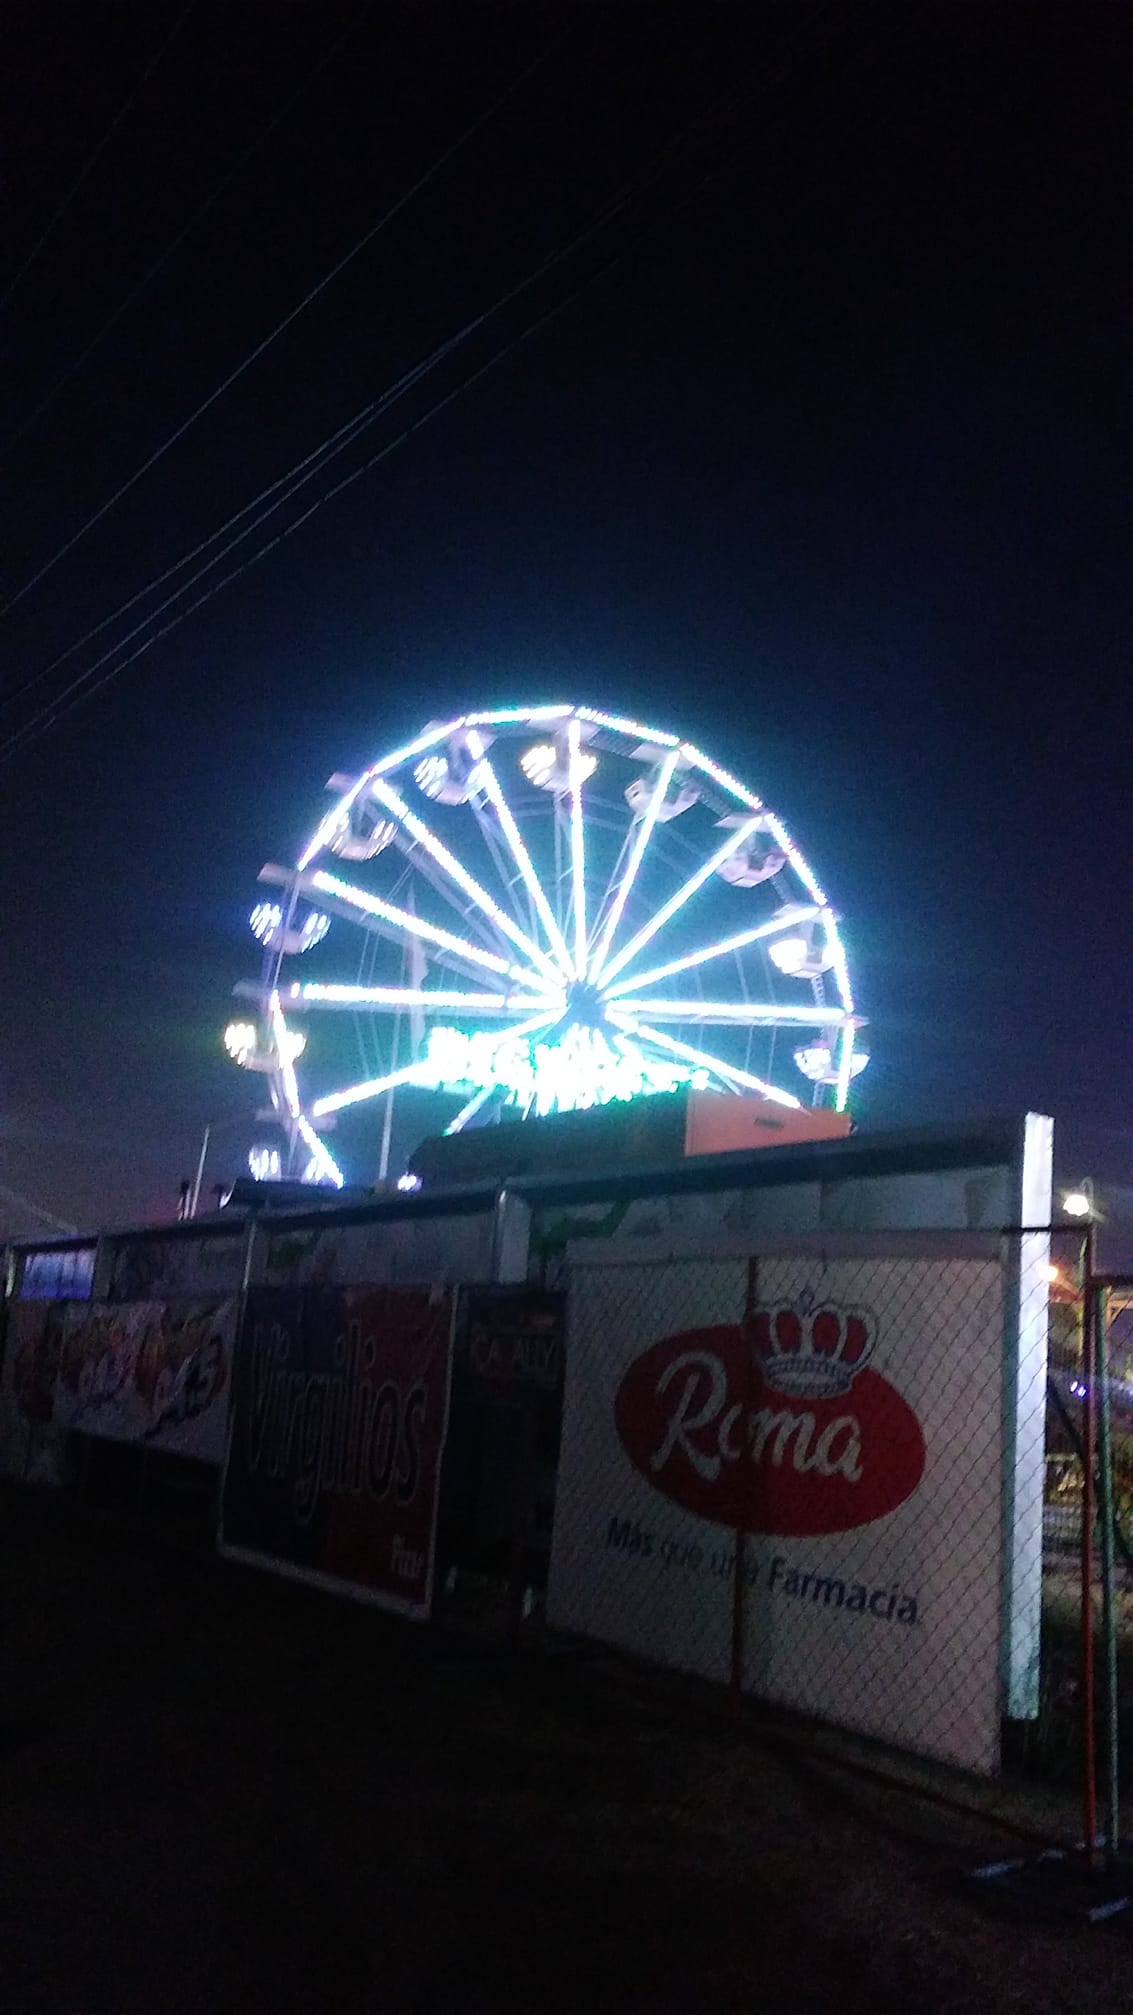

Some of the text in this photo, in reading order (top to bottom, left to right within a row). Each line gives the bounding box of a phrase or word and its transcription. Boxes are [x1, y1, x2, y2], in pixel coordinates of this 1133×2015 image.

[249, 1318, 428, 1525] Virgilios
[652, 1350, 864, 1482] Roma
[607, 1517, 652, 1556] Más
[660, 1534, 704, 1571] que
[767, 1555, 918, 1625] Farmacia
